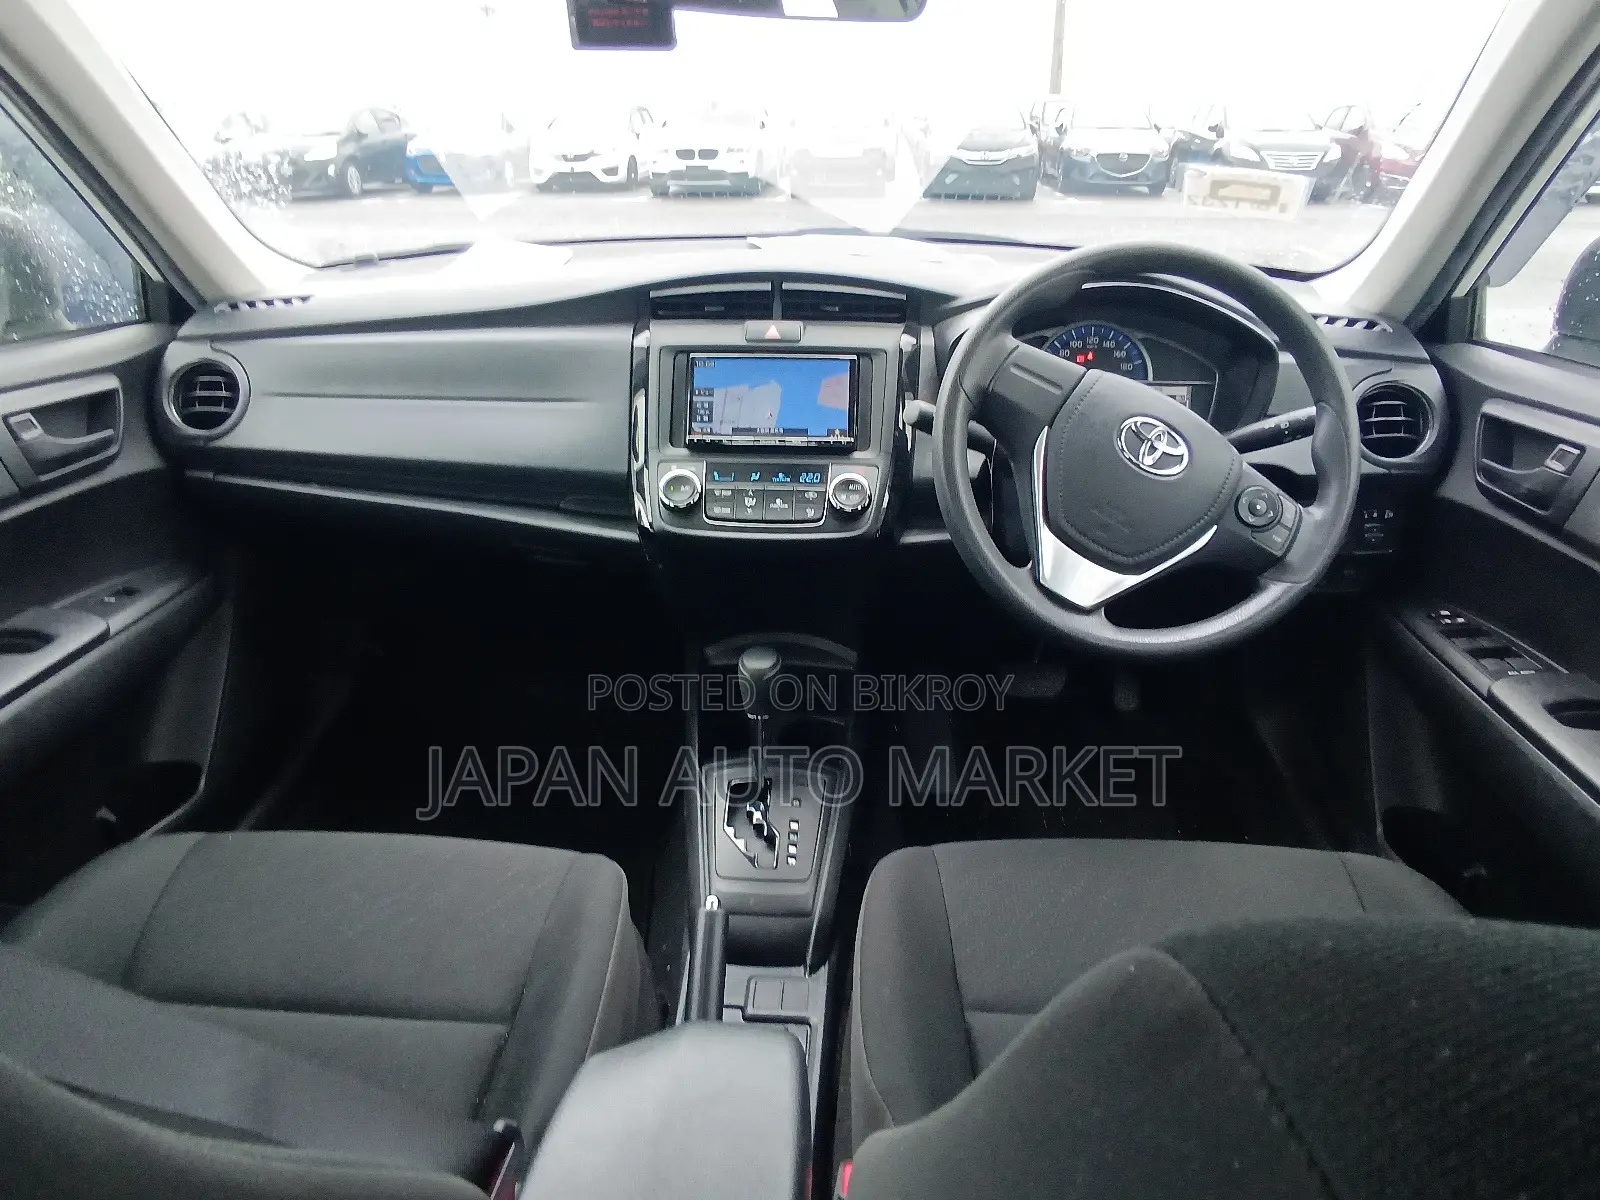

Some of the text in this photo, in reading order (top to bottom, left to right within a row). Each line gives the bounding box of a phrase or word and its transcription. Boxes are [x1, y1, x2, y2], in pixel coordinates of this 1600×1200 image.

[1069, 340, 1083, 349] 100
[1086, 335, 1099, 345] 120
[1103, 340, 1116, 349] 140
[1113, 349, 1127, 359] 160
[1120, 362, 1133, 371] 180
[848, 483, 862, 491] AUTO
